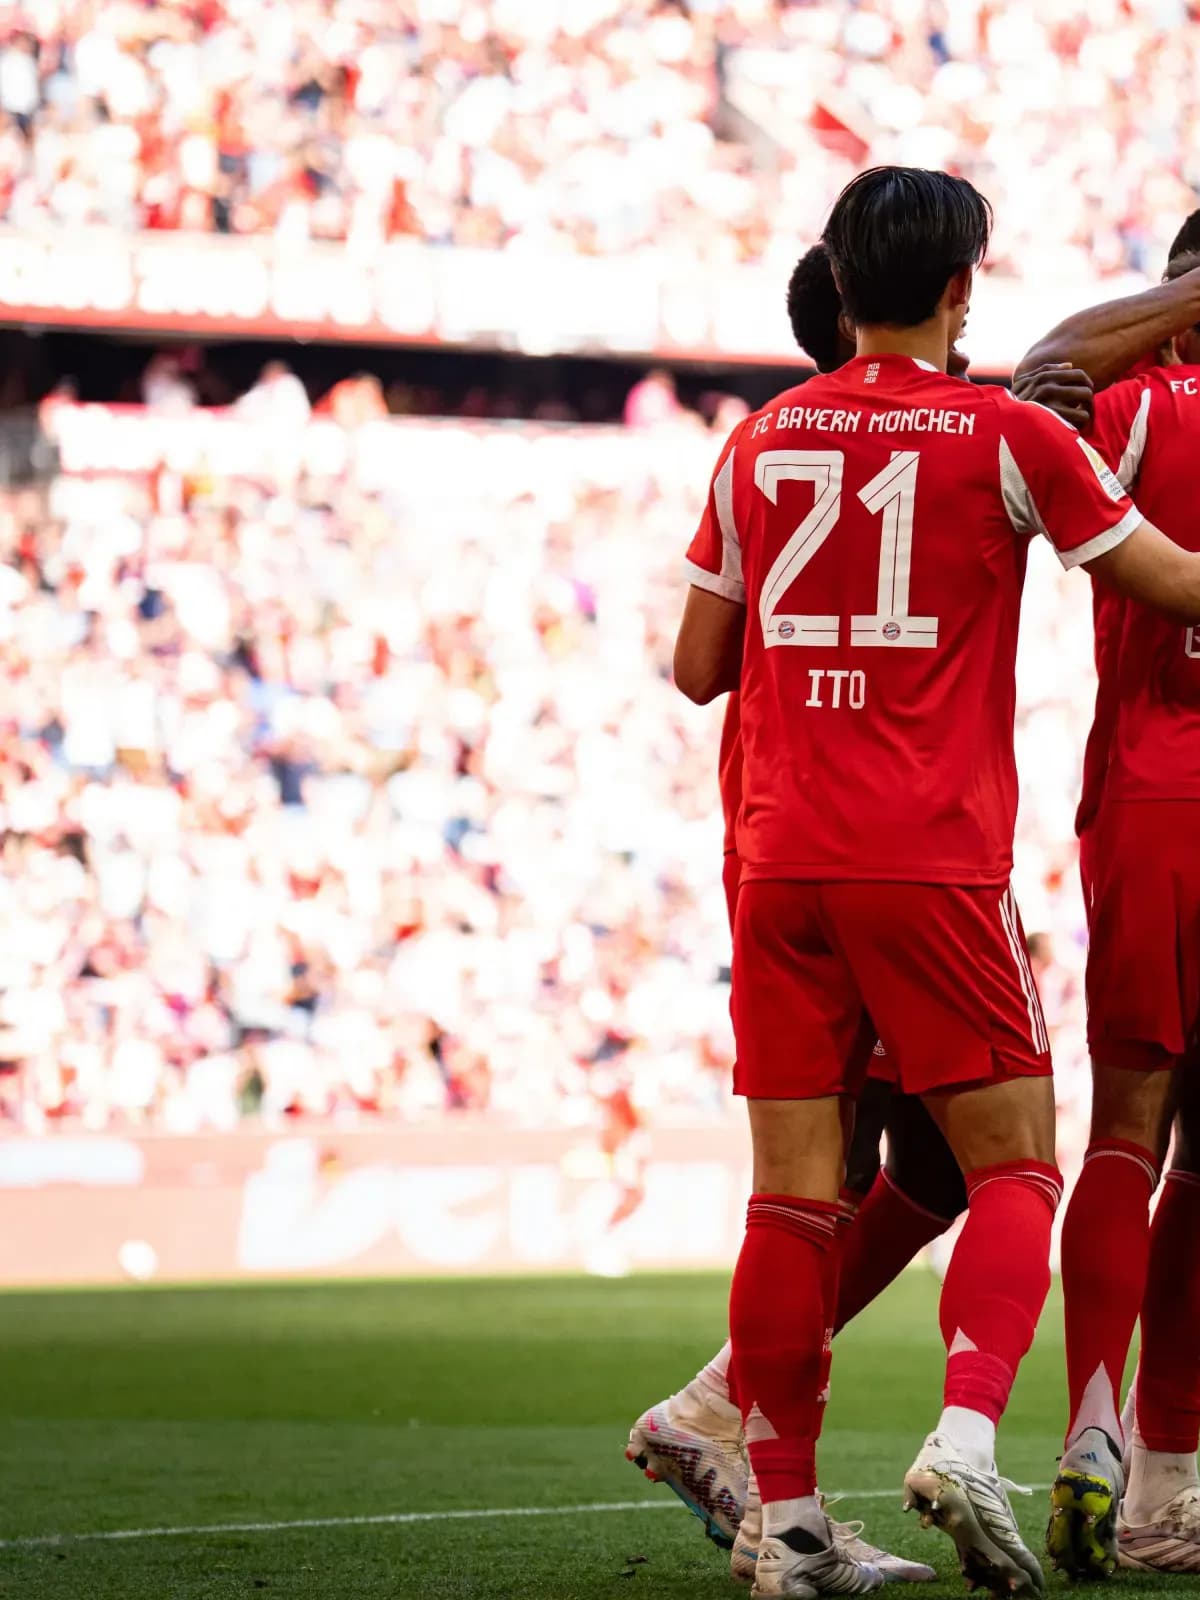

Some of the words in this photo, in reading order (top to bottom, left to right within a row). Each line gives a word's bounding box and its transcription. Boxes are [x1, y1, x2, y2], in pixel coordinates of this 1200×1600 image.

[1169, 378, 1198, 395] FC
[751, 412, 773, 439] FC
[776, 406, 862, 432] BAYERN
[754, 449, 939, 650] 21
[805, 669, 866, 710] ITO
